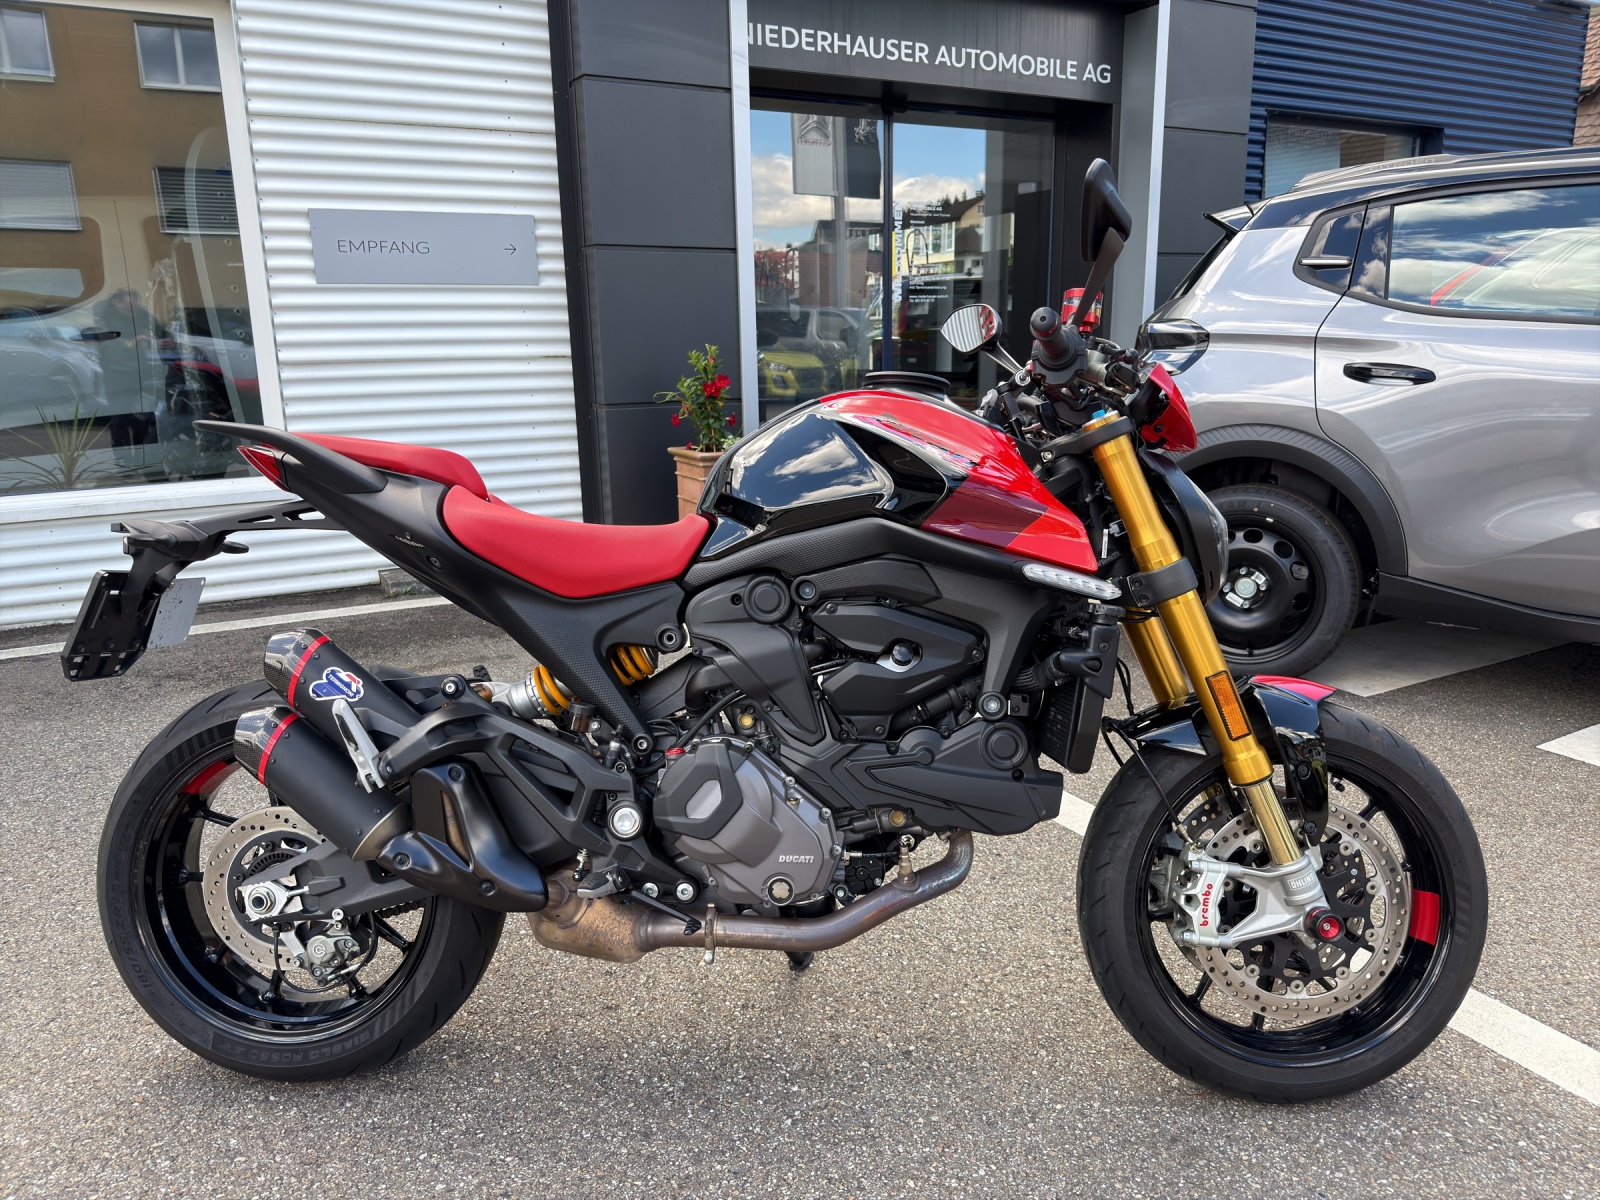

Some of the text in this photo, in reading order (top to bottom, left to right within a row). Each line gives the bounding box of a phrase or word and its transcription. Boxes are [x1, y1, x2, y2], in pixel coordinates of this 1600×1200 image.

[935, 45, 1077, 80] AUTOMOBILE
[1082, 63, 1111, 84] AG
[337, 239, 430, 254] EMPFANG
[328, 674, 354, 697] TERMIGNONI
[778, 855, 815, 864] DUCATI
[1200, 883, 1214, 927] brembo
[308, 1029, 371, 1060] DIABLO
[248, 1050, 303, 1063] ROSSO
